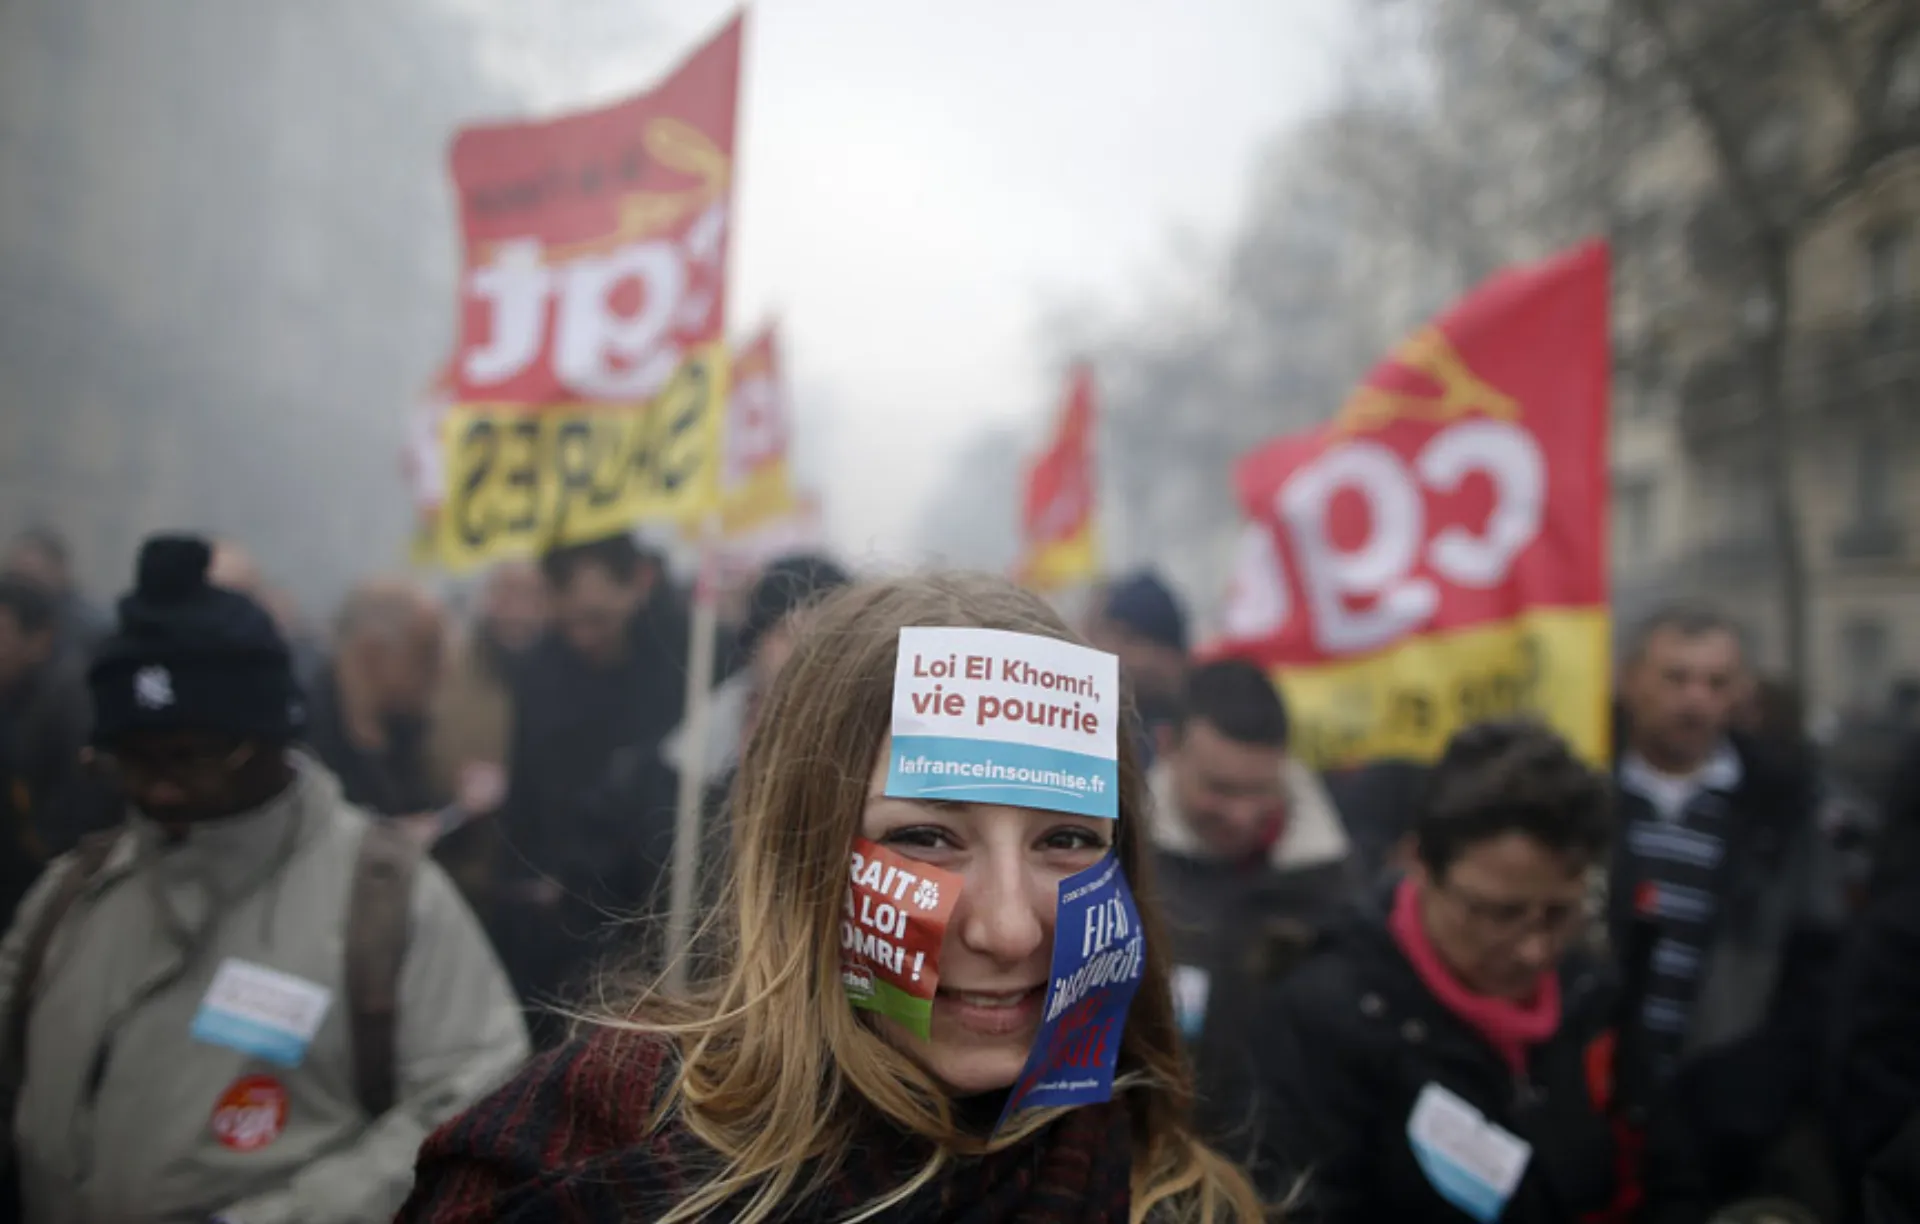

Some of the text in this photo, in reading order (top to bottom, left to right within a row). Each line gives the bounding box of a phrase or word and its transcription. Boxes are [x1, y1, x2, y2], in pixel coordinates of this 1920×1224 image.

[913, 655, 1100, 702] Loi El Khomri,
[911, 684, 1099, 734] vie pourrie
[899, 755, 1106, 793] lafranceinsoumise.fr
[860, 895, 909, 940] LOI
